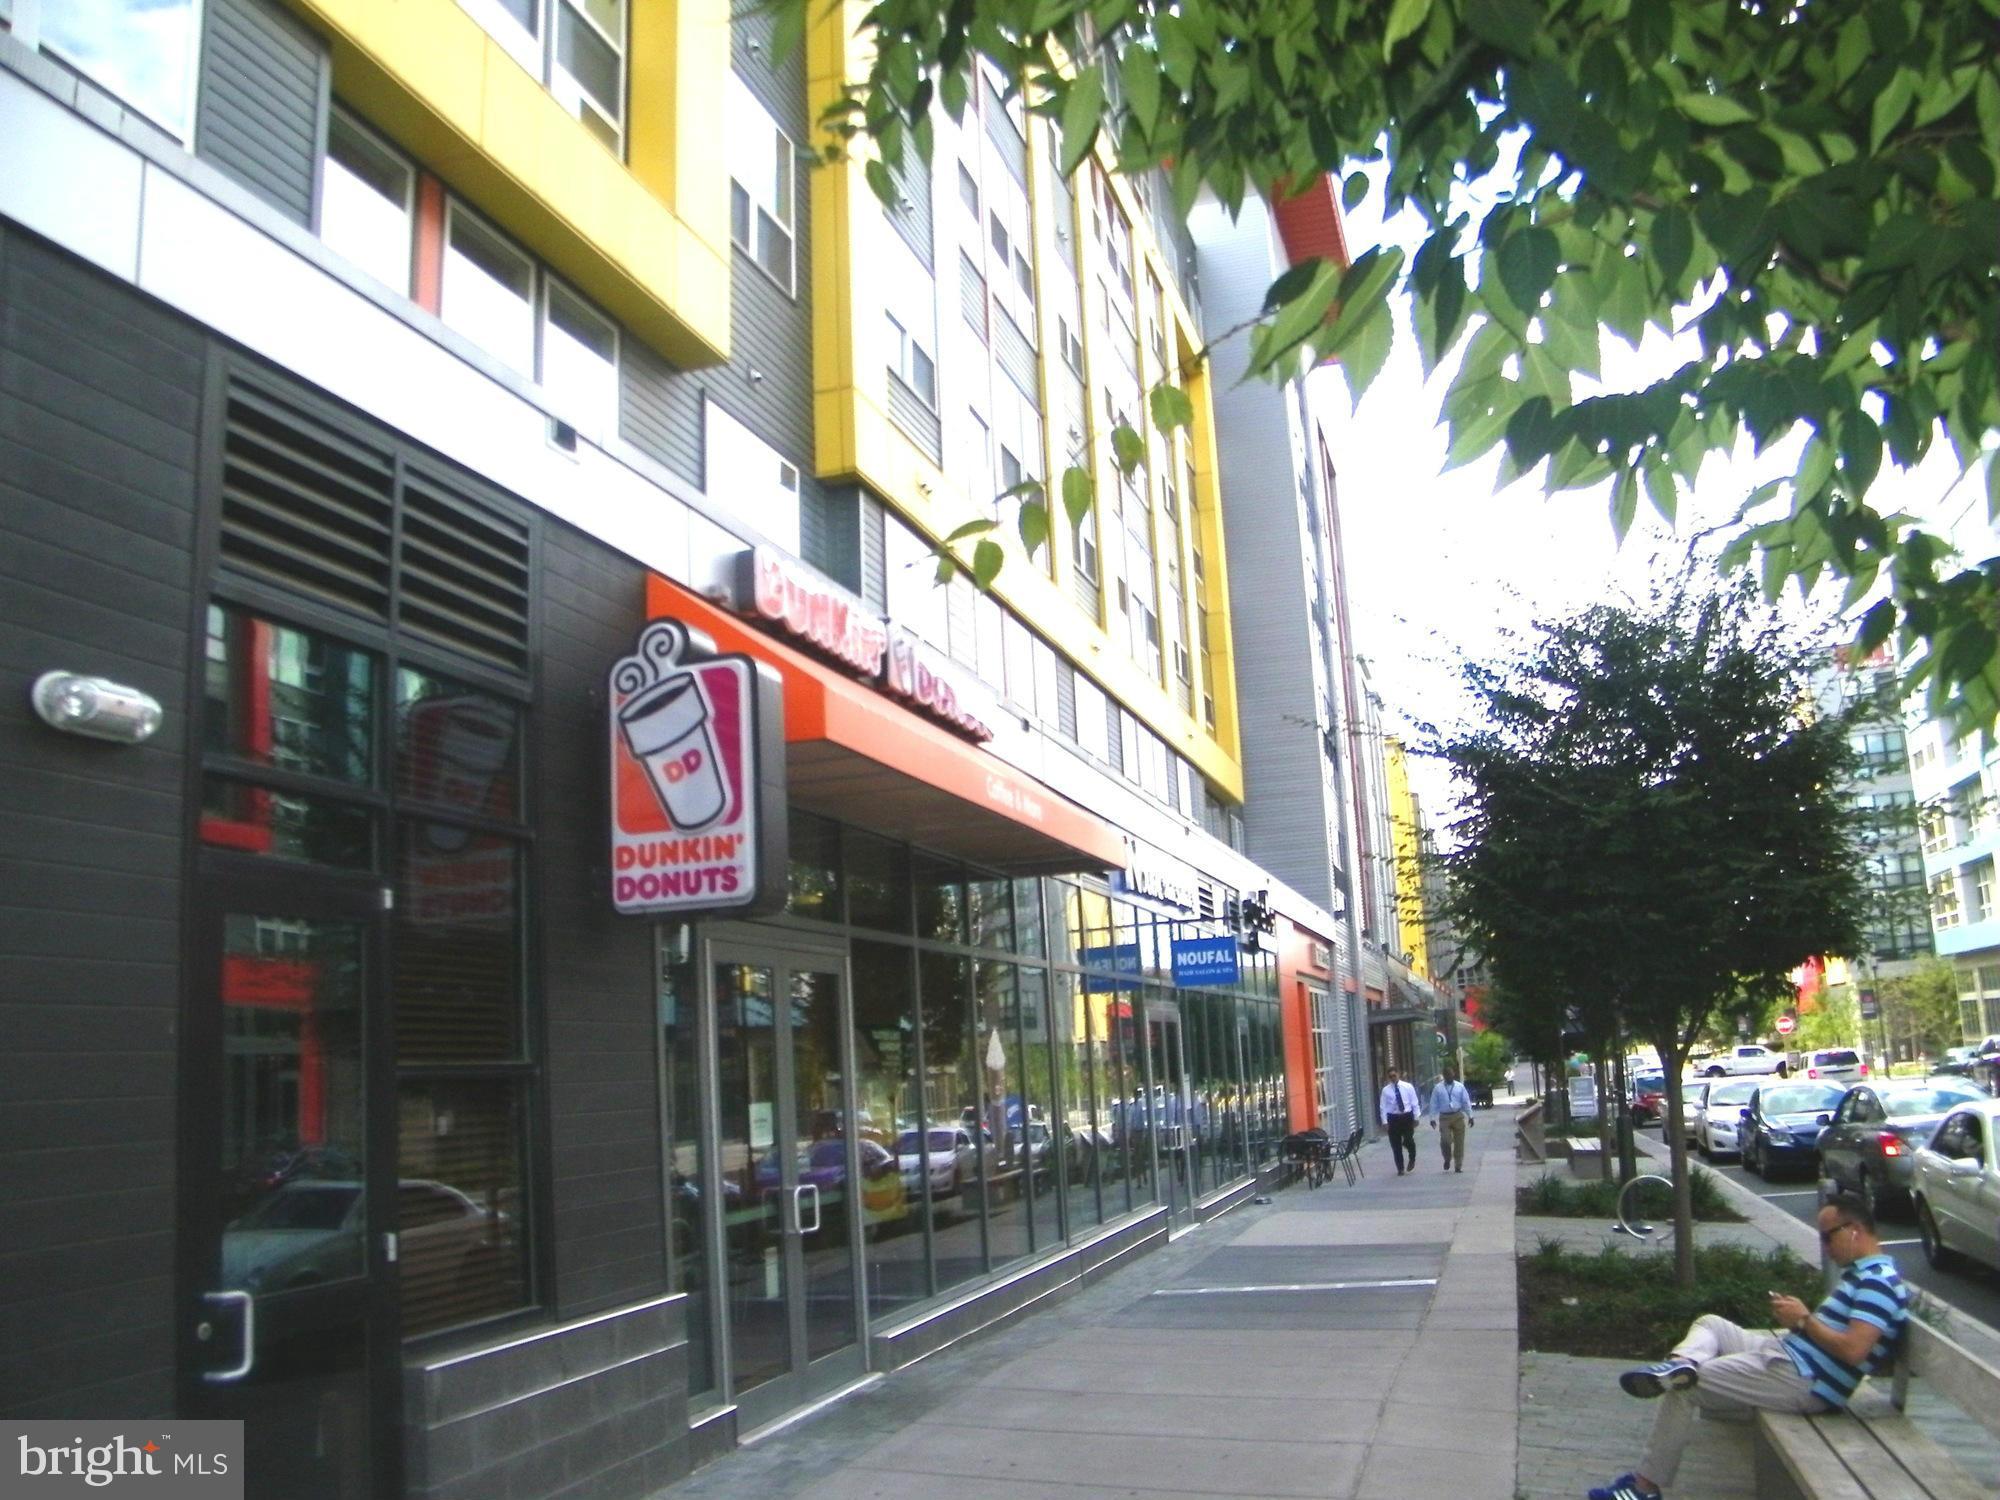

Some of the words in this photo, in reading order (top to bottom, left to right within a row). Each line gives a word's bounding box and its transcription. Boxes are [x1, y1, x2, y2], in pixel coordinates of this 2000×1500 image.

[662, 748, 702, 784] DD
[615, 833, 744, 870] DUNKIN'
[616, 865, 739, 901] DONUTS
[1177, 950, 1233, 966] NOUFAL
